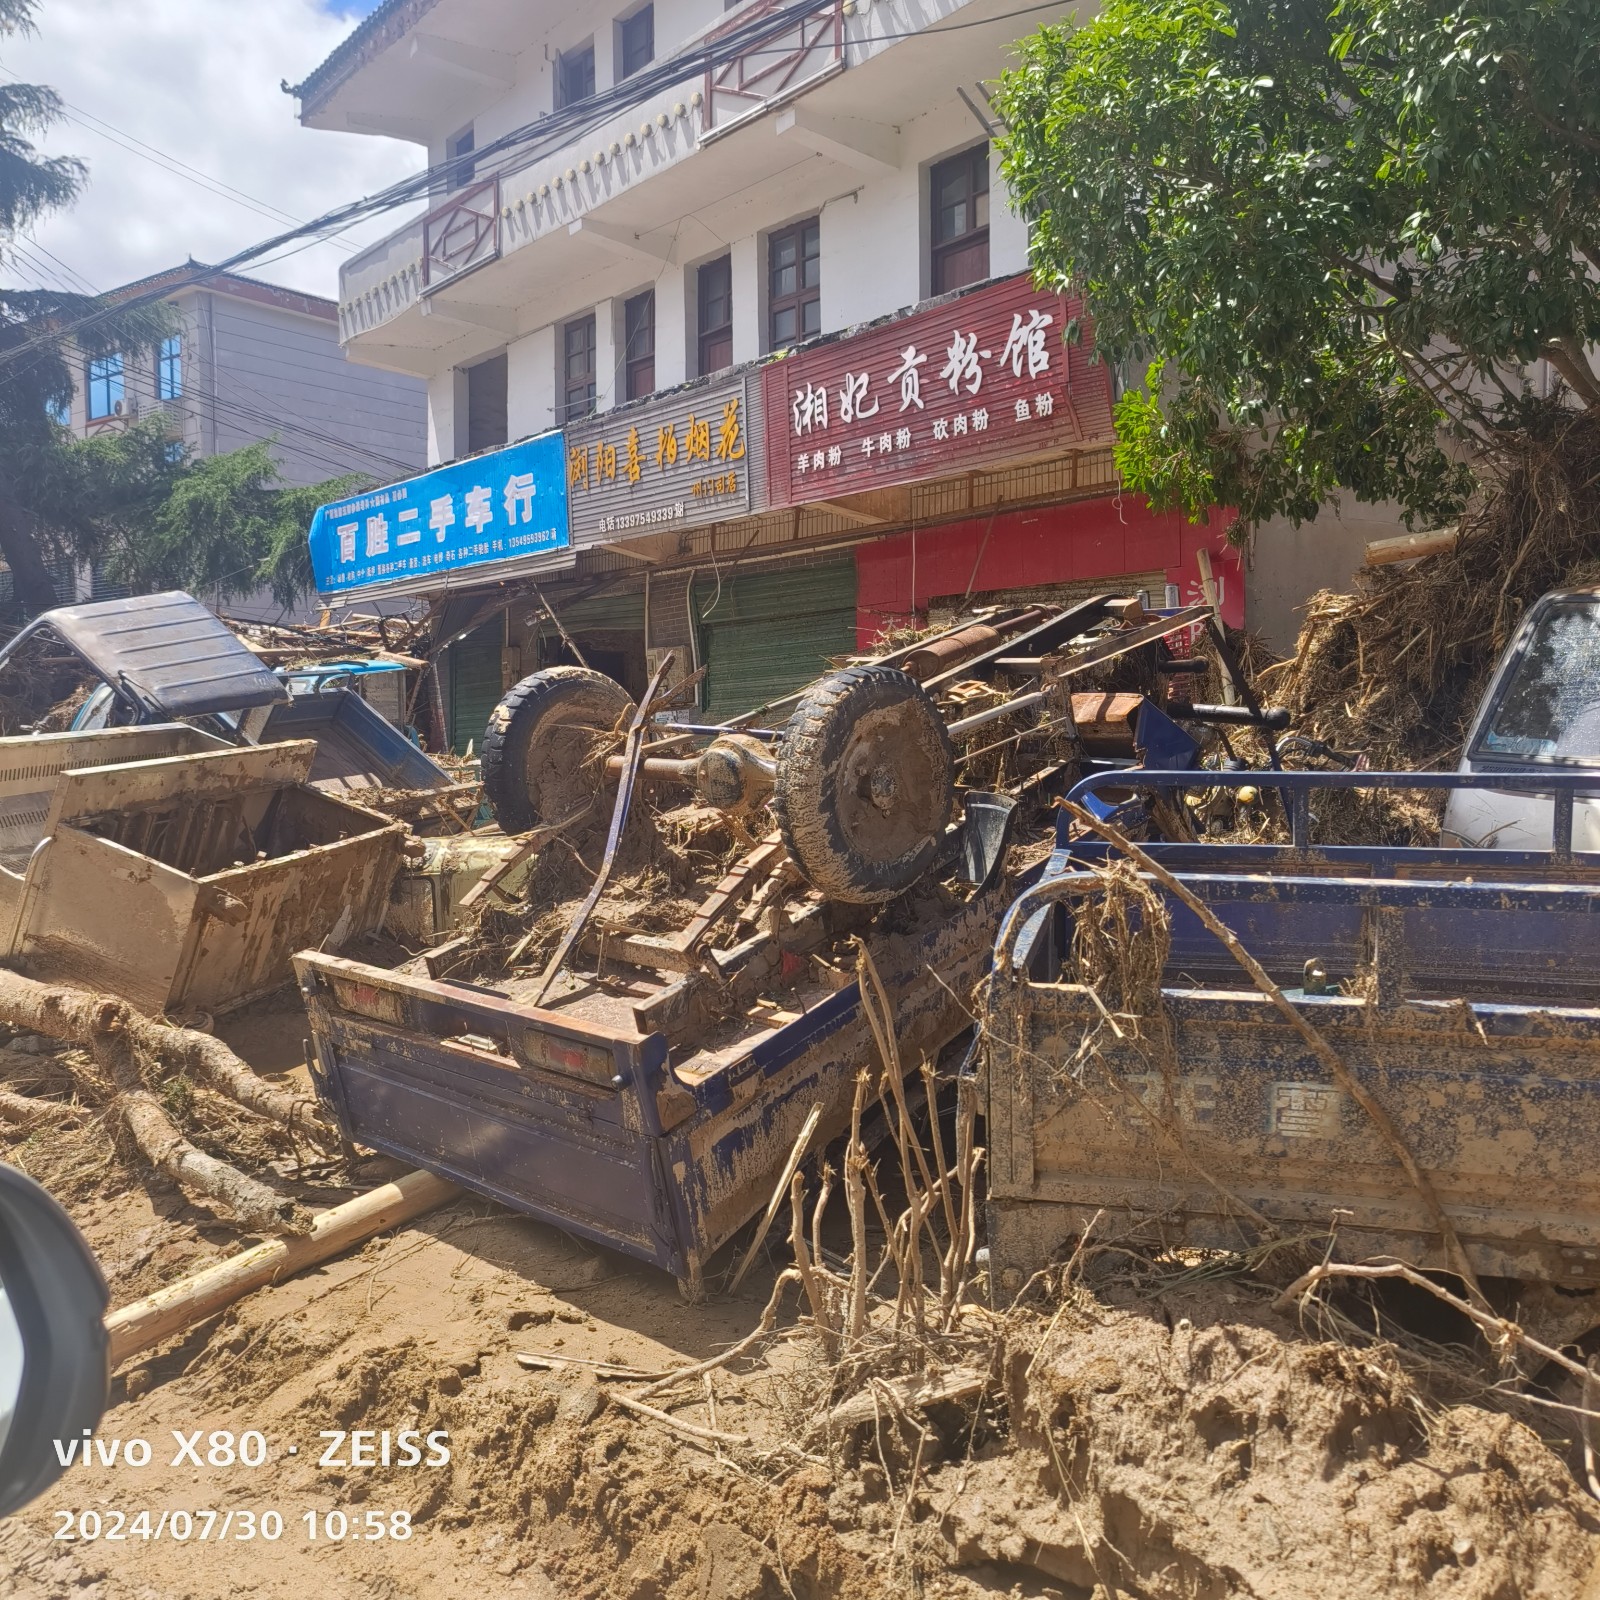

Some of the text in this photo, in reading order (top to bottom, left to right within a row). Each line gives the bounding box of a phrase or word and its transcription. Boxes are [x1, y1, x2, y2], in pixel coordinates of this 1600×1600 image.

[792, 309, 1053, 437] 湘妃贡粉馆
[797, 391, 1054, 474] 羊肉粉 牛肉粉 砍肉粉 鱼粉
[337, 472, 536, 564] 百胜二手车行
